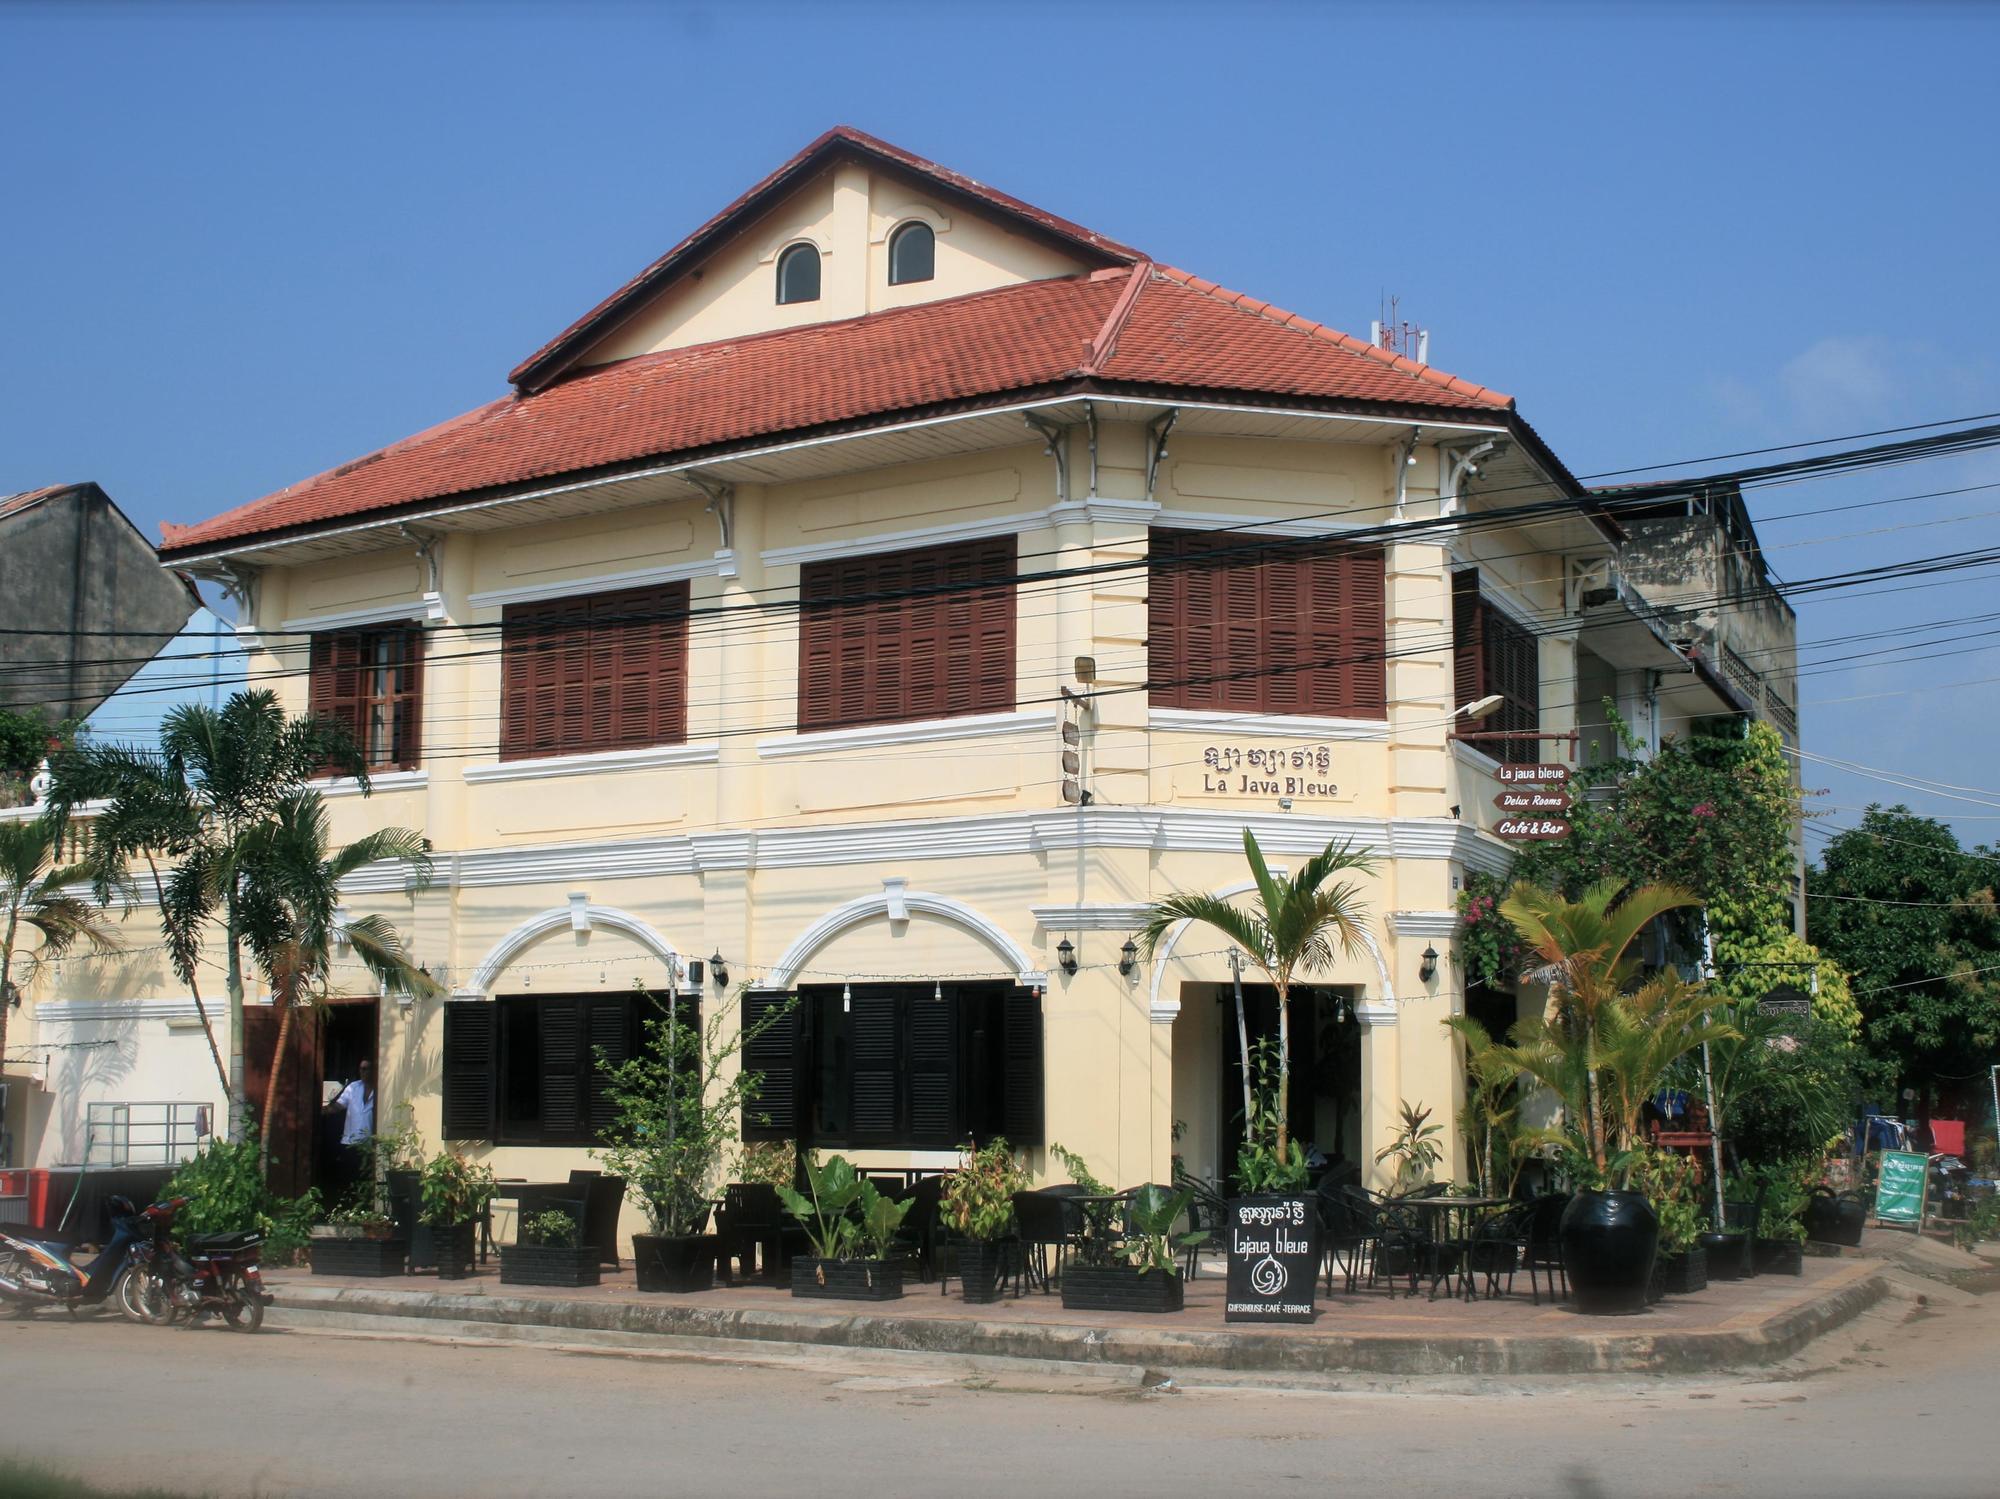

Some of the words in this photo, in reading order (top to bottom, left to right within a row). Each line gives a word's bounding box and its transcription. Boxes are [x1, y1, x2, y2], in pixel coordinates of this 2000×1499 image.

[1500, 767, 1512, 779] La
[1538, 767, 1564, 779] bleue
[1204, 774, 1226, 792] La
[1239, 775, 1279, 794] Java
[1286, 777, 1338, 796] Bleue
[1504, 795, 1529, 806] Delux
[1532, 795, 1562, 806] Rooms
[1500, 822, 1530, 834] Café
[1530, 822, 1538, 834] &
[1541, 822, 1563, 834] Bar
[1276, 1228, 1308, 1254] bleue
